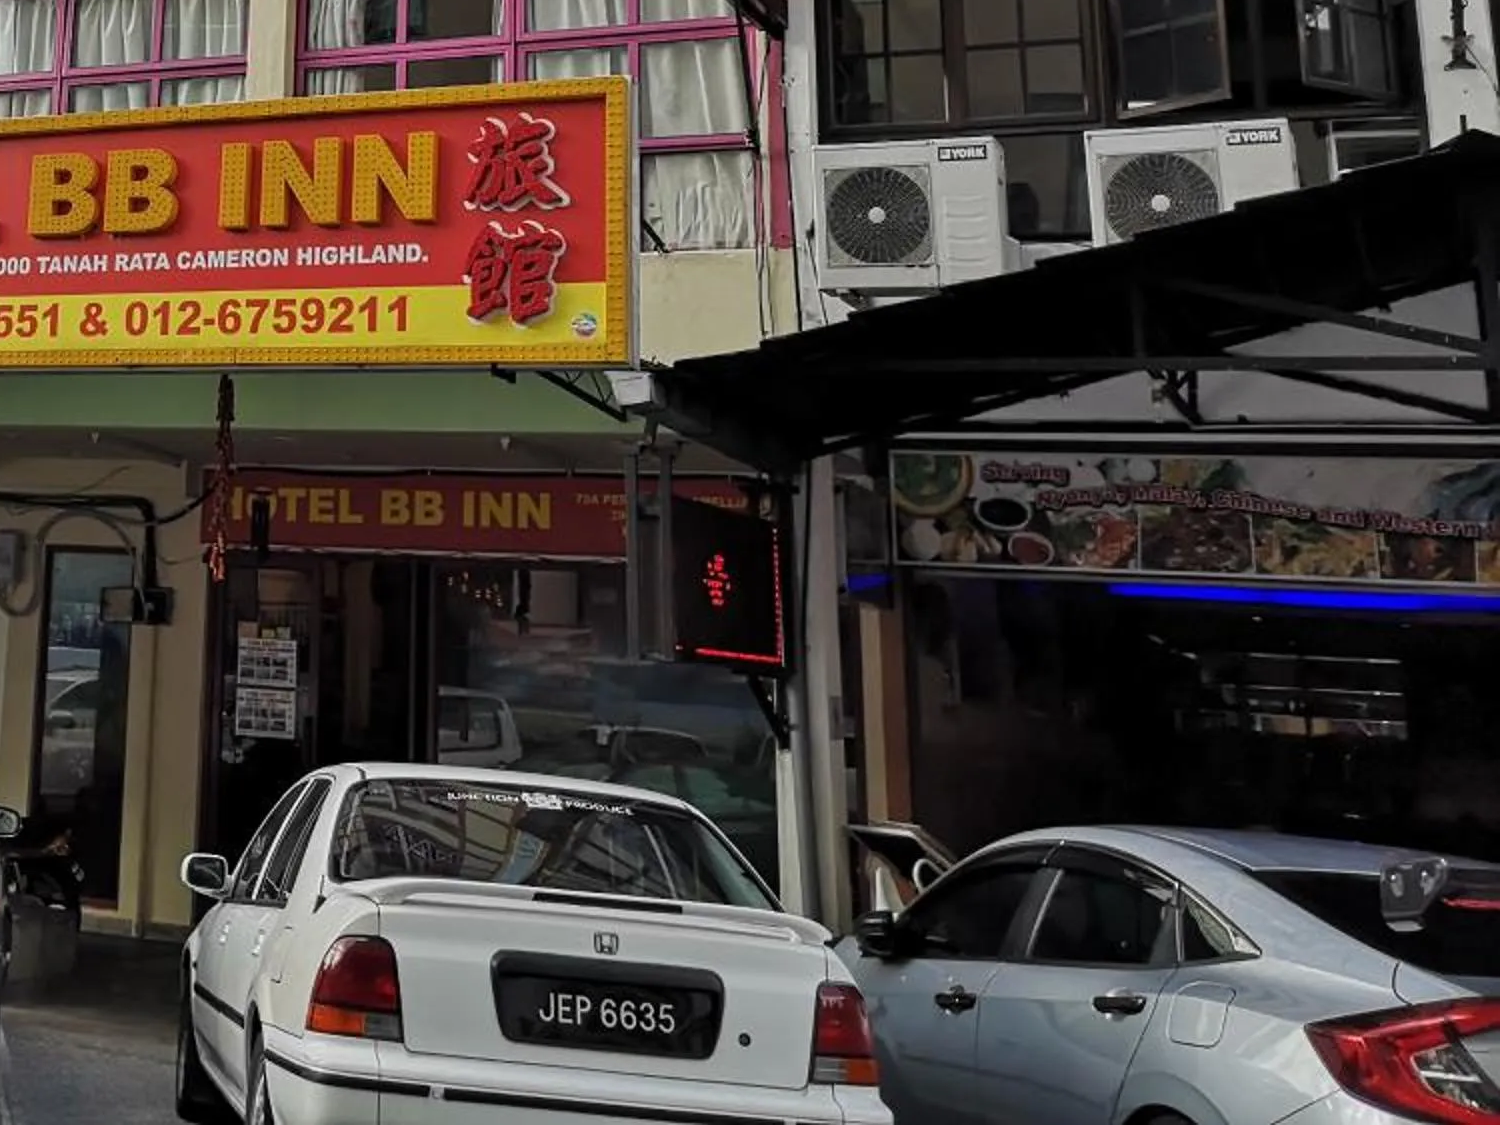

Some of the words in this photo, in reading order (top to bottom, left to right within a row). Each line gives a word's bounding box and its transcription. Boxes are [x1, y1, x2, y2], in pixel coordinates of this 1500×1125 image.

[950, 146, 985, 160] YORK
[1241, 129, 1280, 143] YORK
[27, 147, 180, 239] BB
[218, 130, 439, 229] INN
[463, 111, 571, 329] 旅館
[36, 254, 109, 275] TANAH
[114, 251, 172, 272] RATA
[177, 247, 290, 271] CAMERON
[296, 242, 430, 267] HIGHLAND.
[79, 302, 109, 337] &
[124, 294, 410, 337] 012-6759211
[380, 488, 446, 527] BB
[462, 489, 552, 530] INN
[538, 991, 593, 1026] JEP
[600, 997, 676, 1035] 6635
